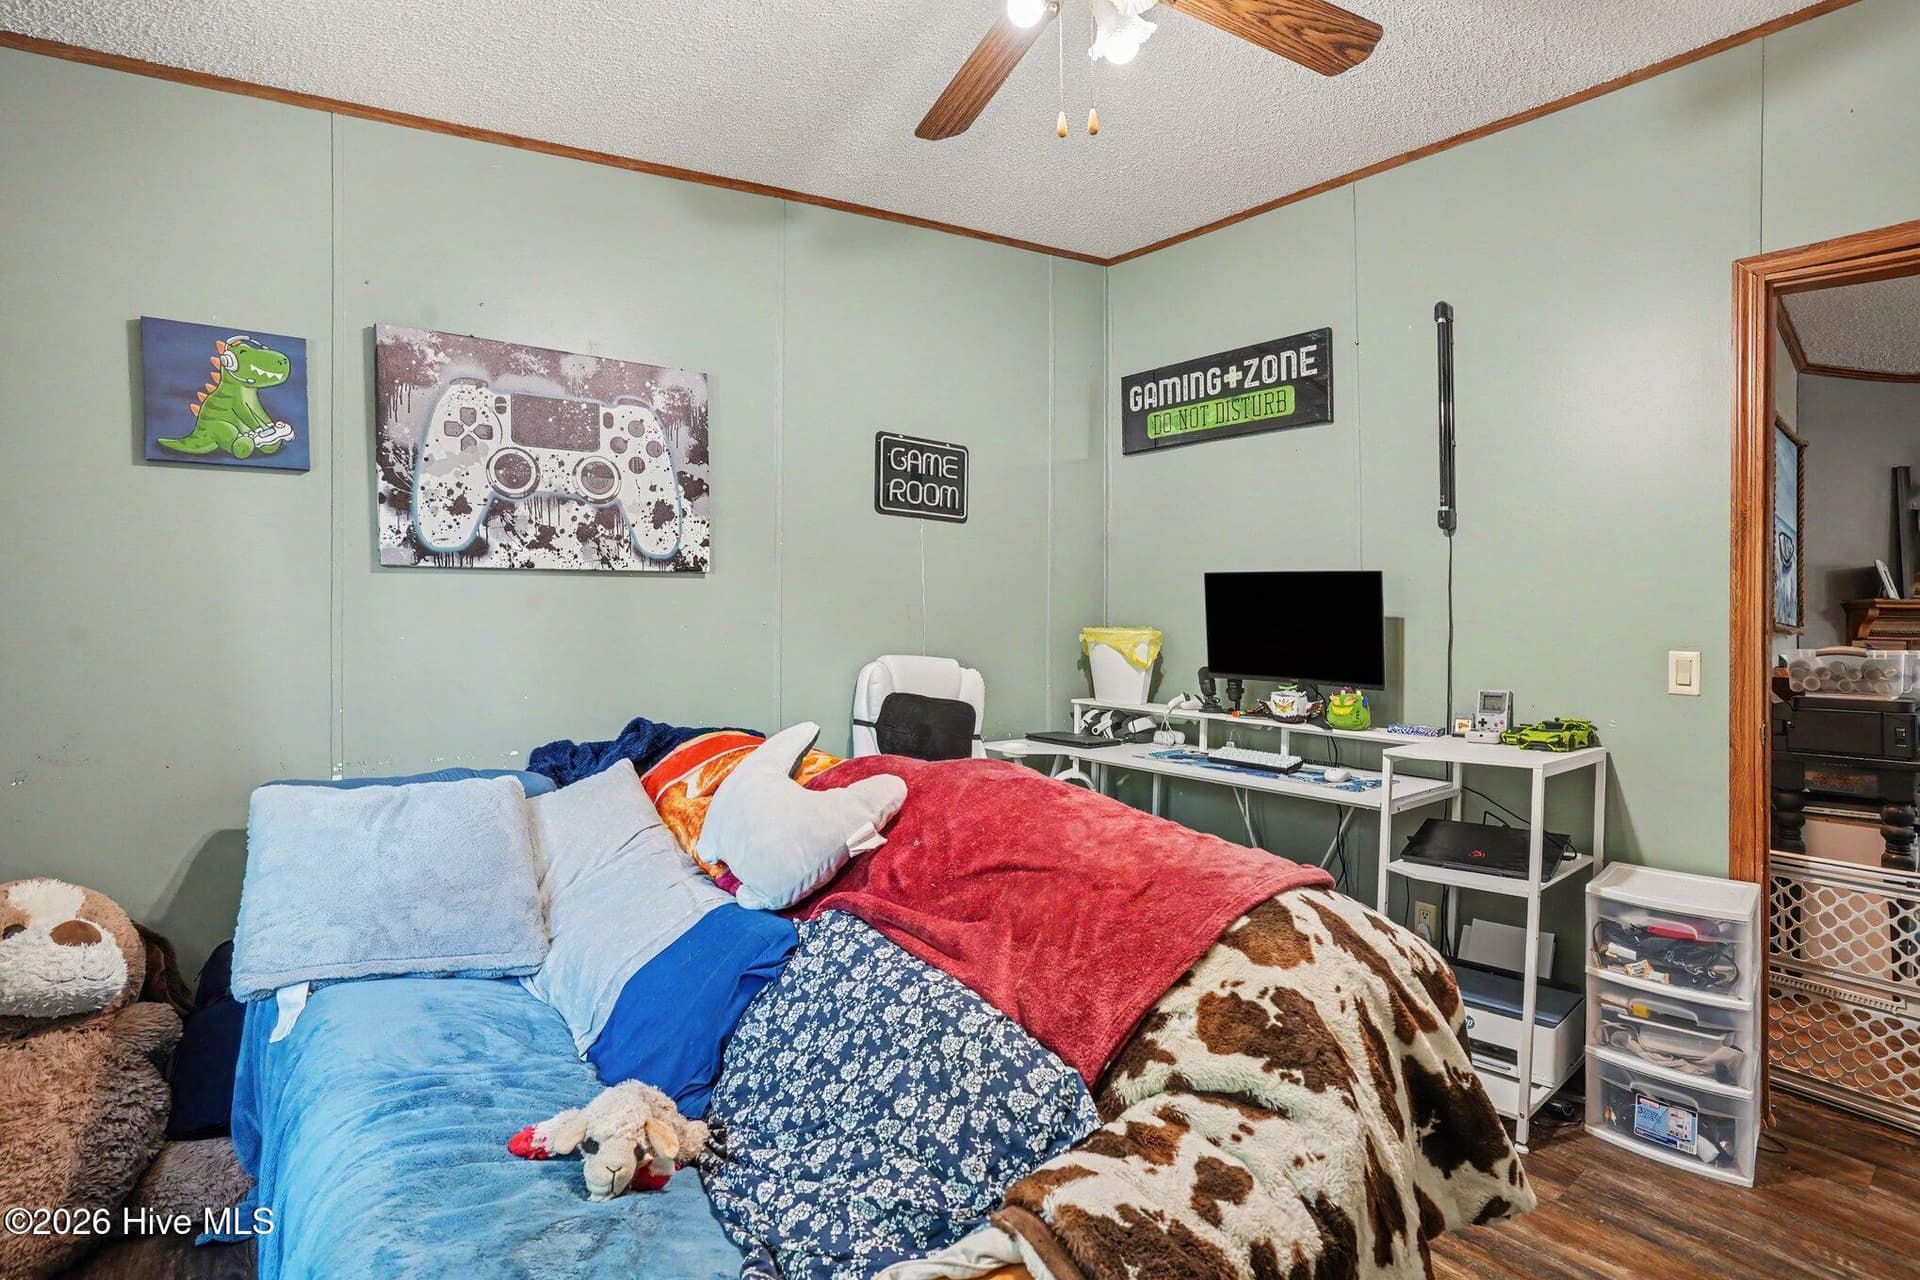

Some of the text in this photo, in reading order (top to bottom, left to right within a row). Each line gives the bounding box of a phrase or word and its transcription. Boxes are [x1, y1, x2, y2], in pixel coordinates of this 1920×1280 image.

[1153, 388, 1288, 436] DO NOT DISTURB
[890, 447, 959, 479] GAME
[889, 478, 959, 510] ROOM
